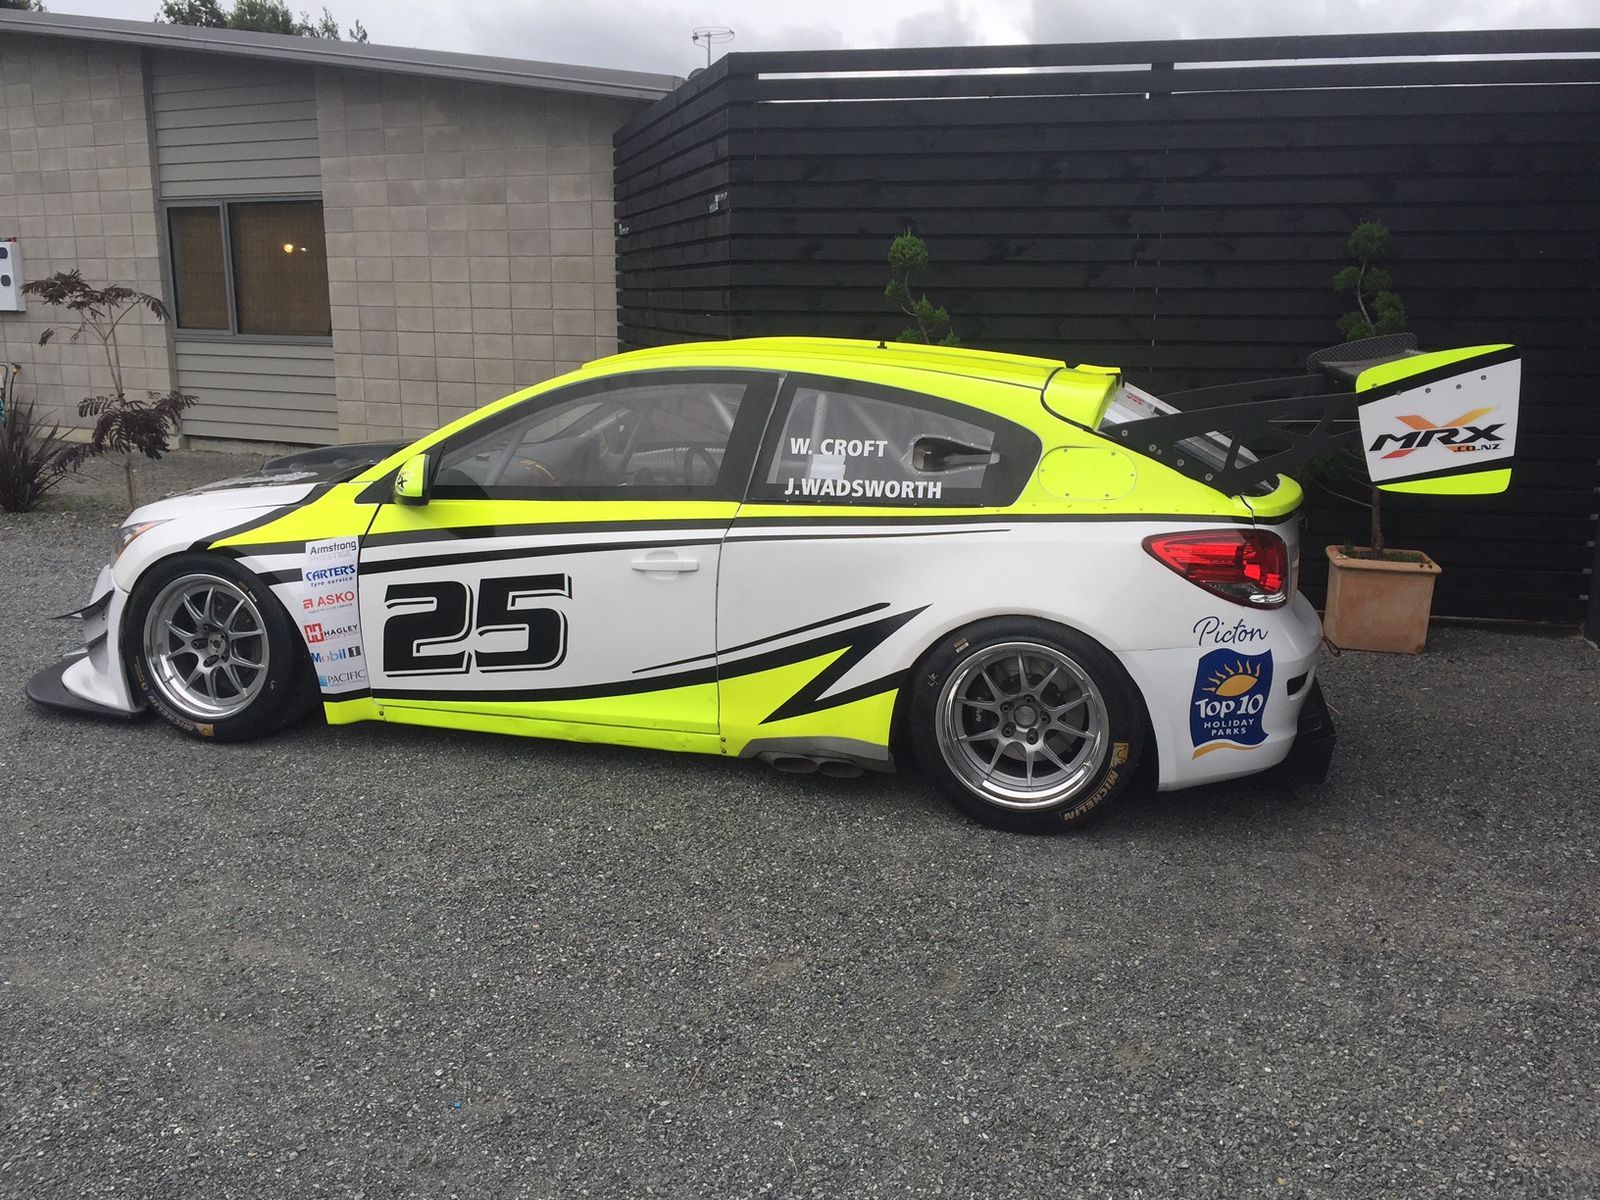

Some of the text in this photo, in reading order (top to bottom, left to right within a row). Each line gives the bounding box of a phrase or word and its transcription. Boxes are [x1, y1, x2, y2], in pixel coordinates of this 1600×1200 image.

[1369, 423, 1506, 452] MRX
[790, 437, 888, 458] W. CROFT
[784, 477, 942, 499] J.WADSWORTH
[310, 540, 357, 555] Armstrong
[306, 564, 356, 581] CARTER'S
[317, 590, 355, 607] ASKO
[323, 623, 358, 637] HAGLEY
[383, 573, 572, 677] 25
[1193, 615, 1269, 646] Picton
[310, 648, 347, 664] Mobil
[327, 669, 368, 684] PACIFIC
[1195, 693, 1264, 719] Top 10
[1203, 718, 1255, 729] HOLIDAY
[1210, 727, 1247, 737] PARKS
[1063, 769, 1120, 821] MICHELIN
